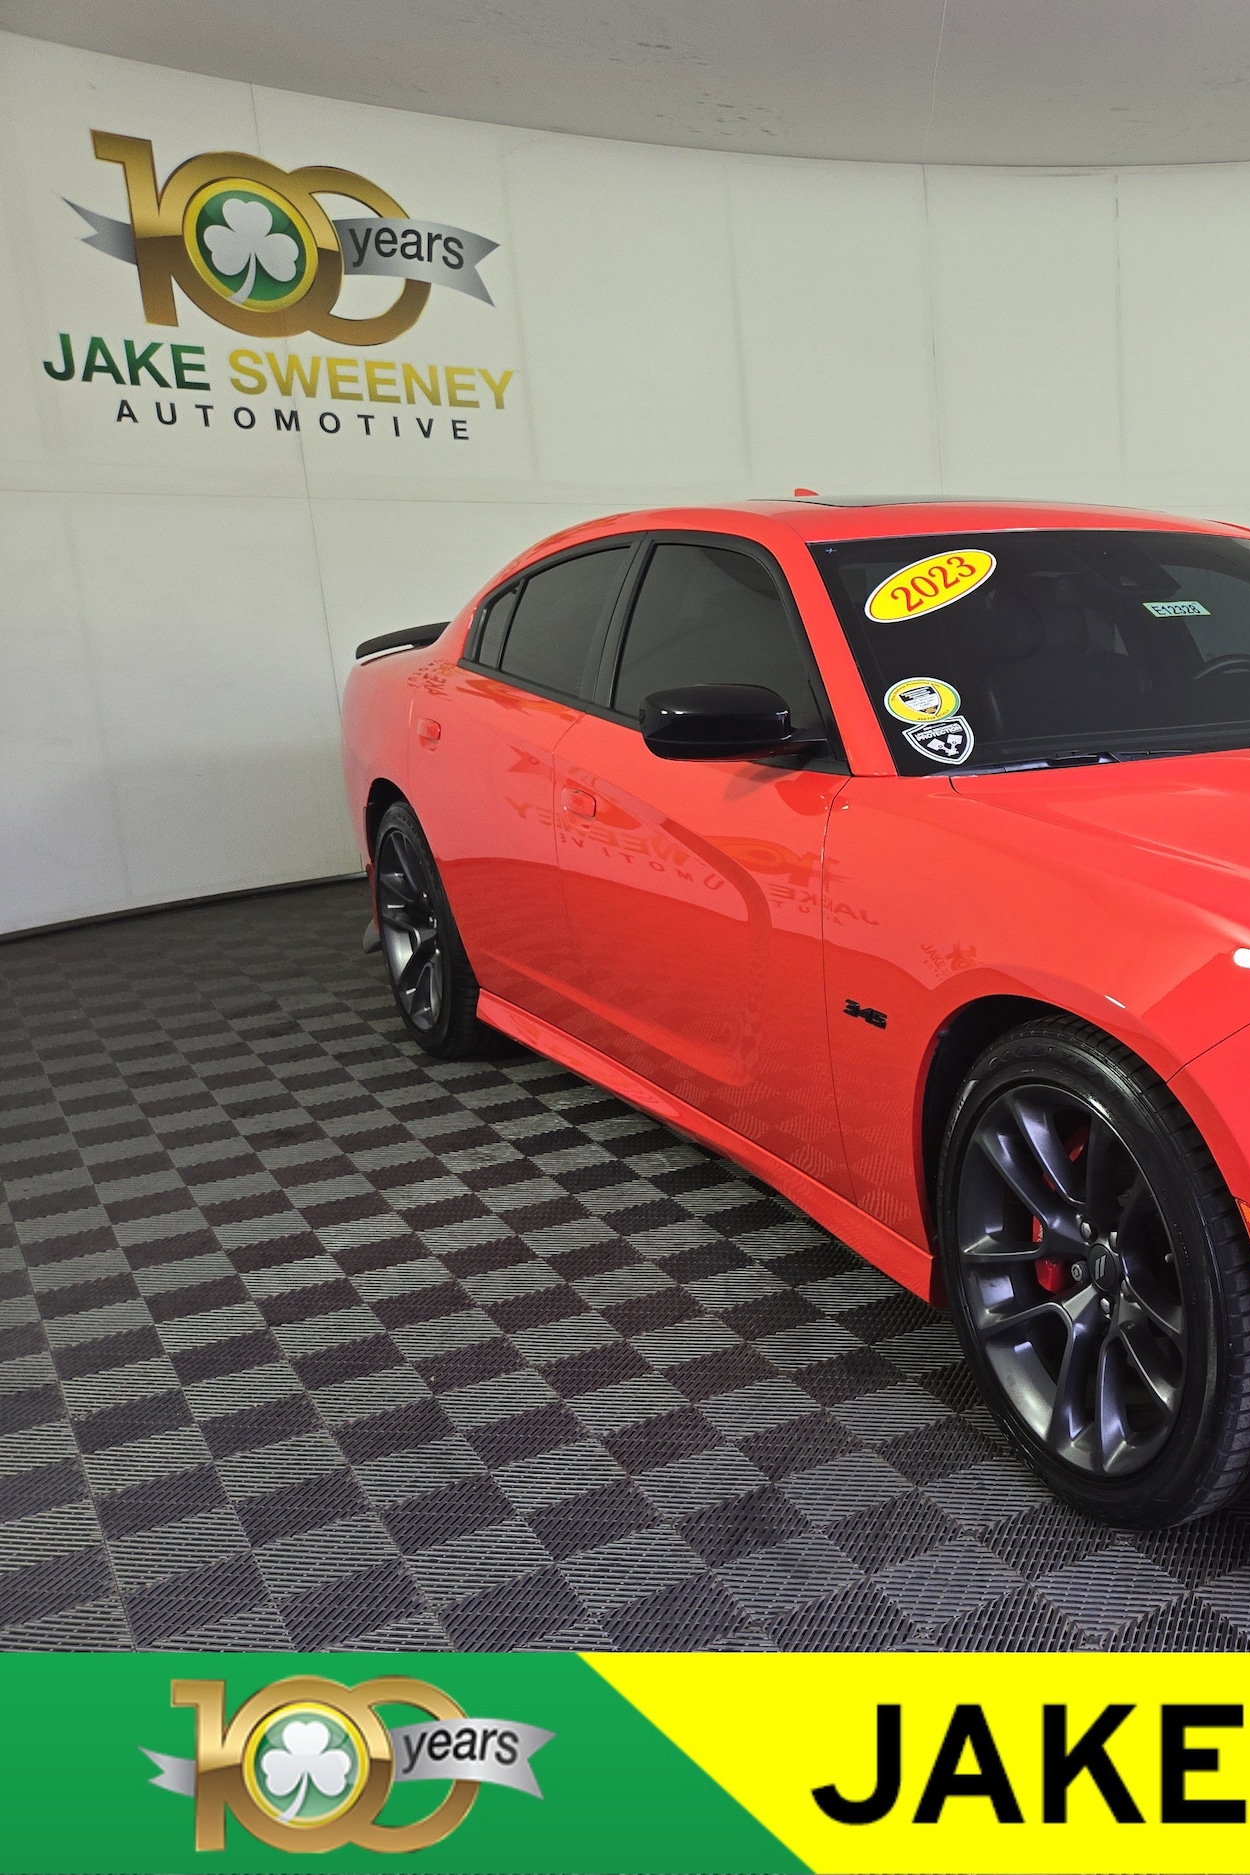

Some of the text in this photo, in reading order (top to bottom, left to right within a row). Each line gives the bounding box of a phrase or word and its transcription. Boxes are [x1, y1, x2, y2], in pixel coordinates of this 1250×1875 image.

[349, 224, 464, 270] years
[43, 332, 515, 410] JAKE SWEENEY
[116, 399, 469, 440] AUTOMOTIVE
[891, 556, 976, 612] 2023
[1151, 604, 1201, 616] E12328
[843, 998, 888, 1030] 345
